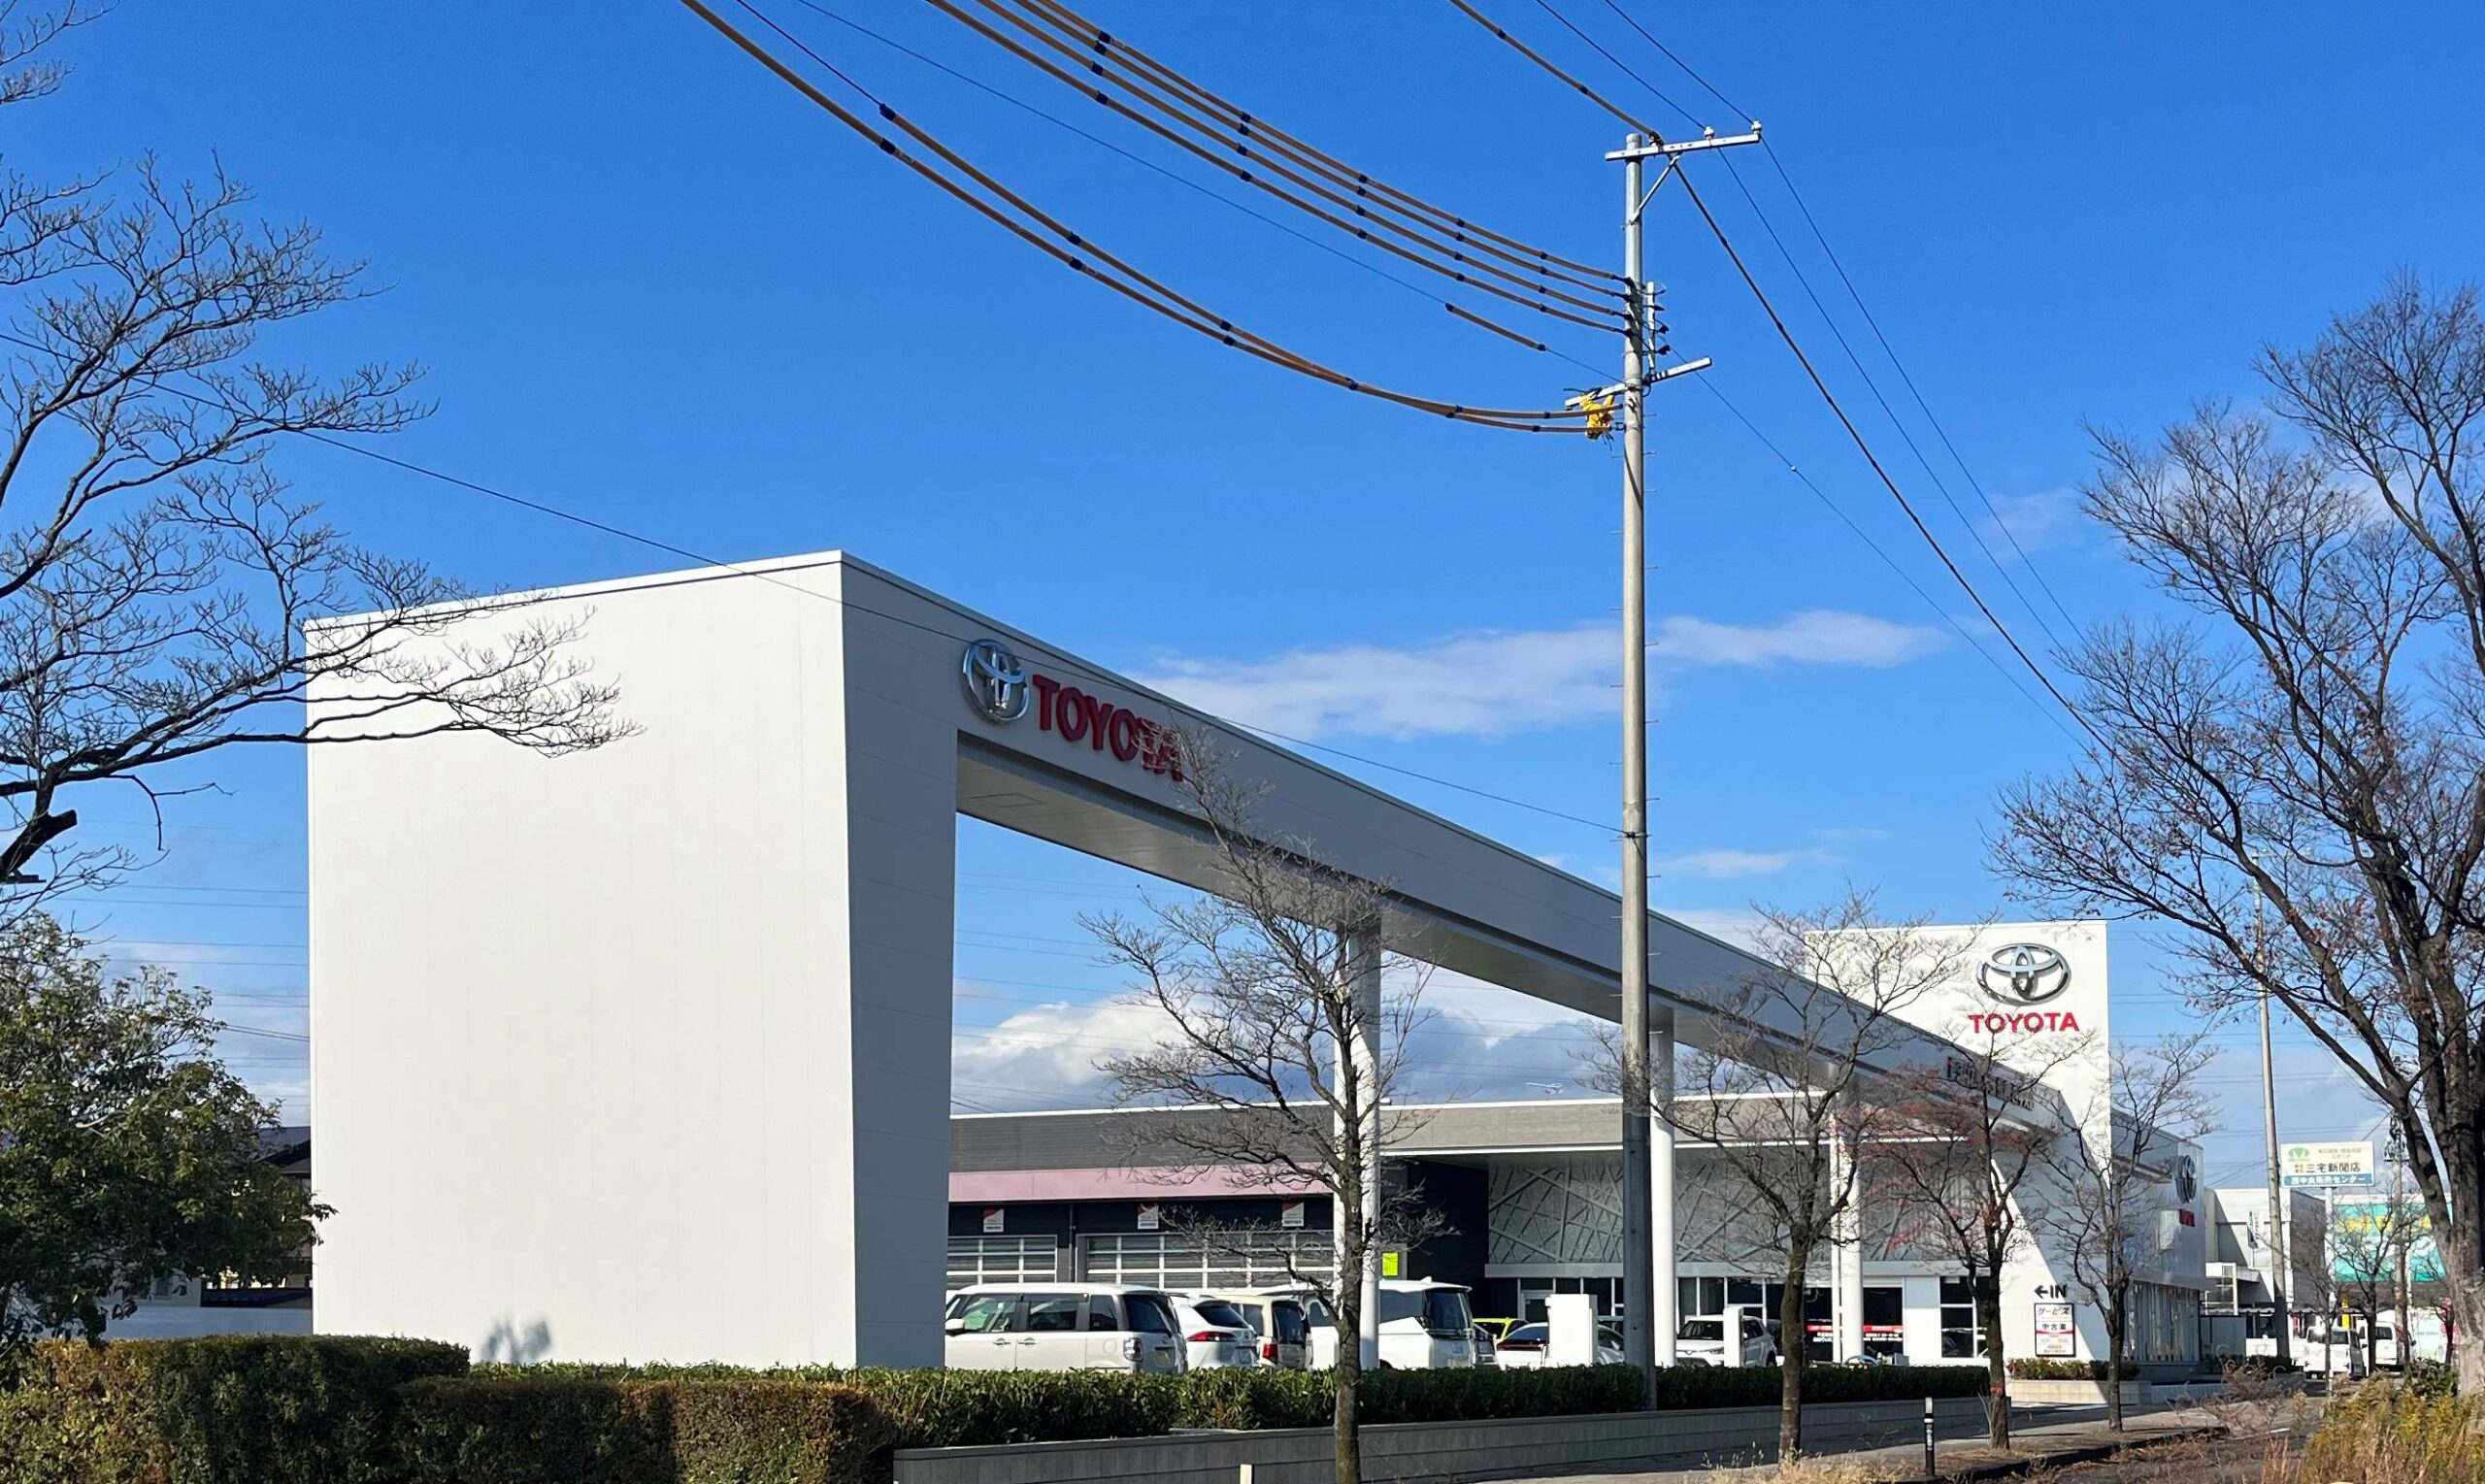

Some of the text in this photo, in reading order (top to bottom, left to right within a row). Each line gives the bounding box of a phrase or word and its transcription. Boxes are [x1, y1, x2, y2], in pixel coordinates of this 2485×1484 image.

[1032, 674, 1184, 782] TOYOTA
[1968, 1012, 2079, 1034] TOYOTA
[2049, 1284, 2067, 1299] IN
